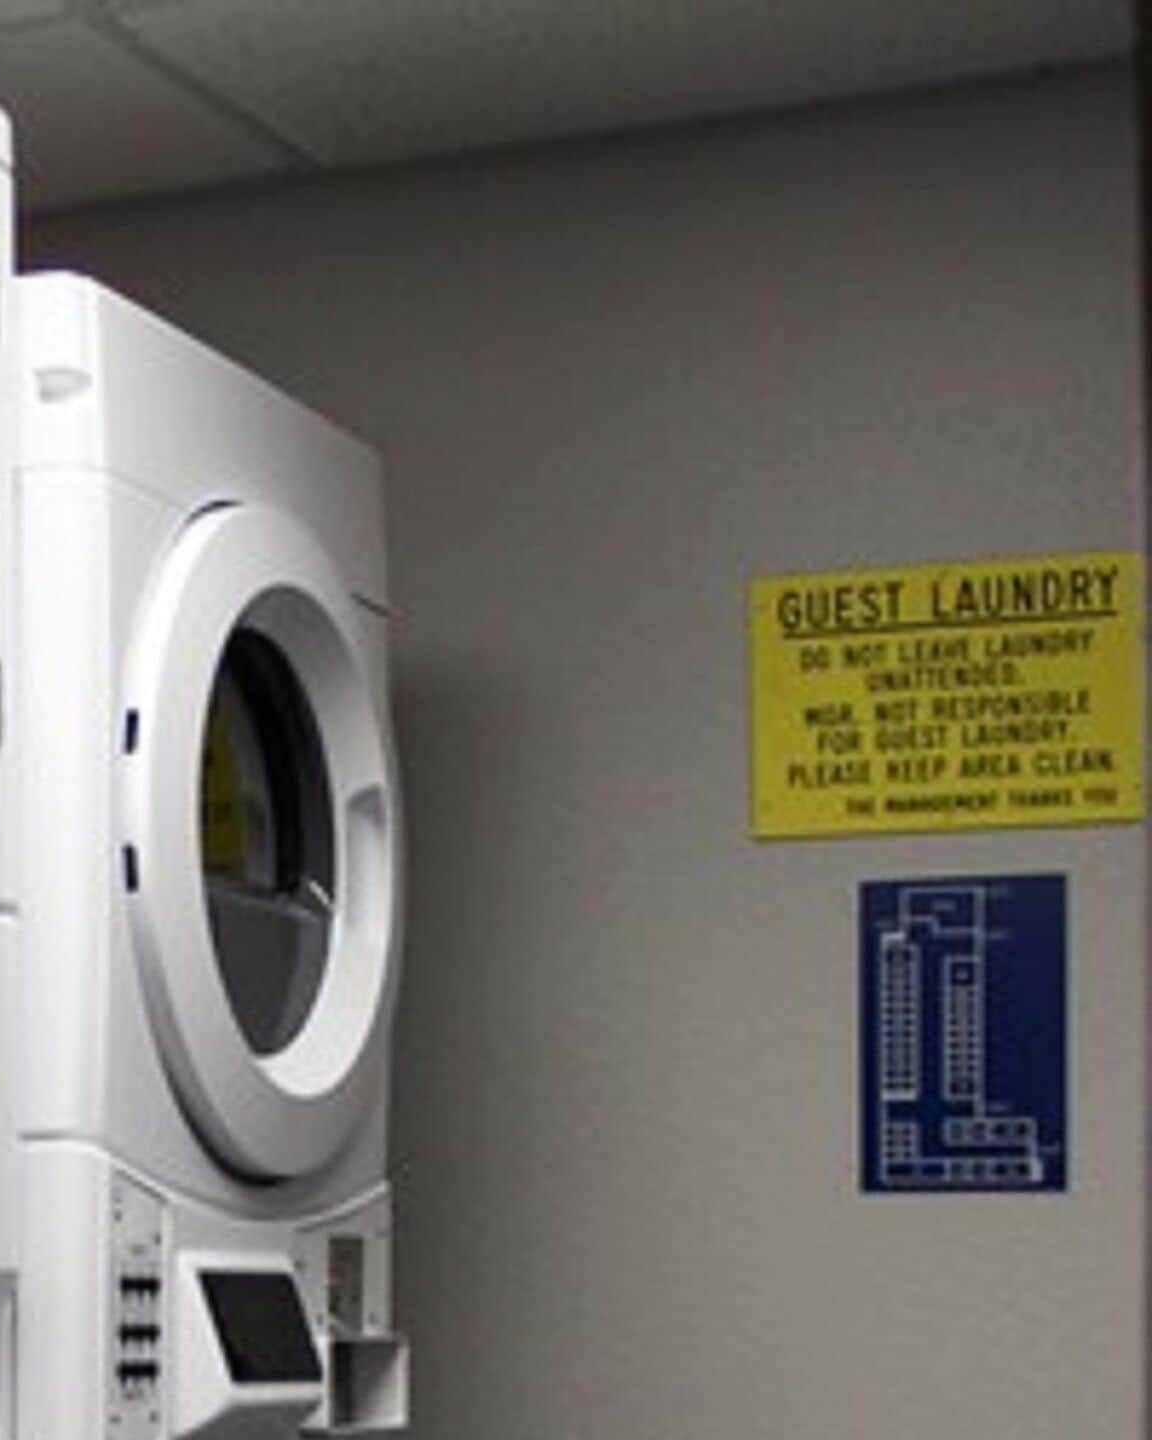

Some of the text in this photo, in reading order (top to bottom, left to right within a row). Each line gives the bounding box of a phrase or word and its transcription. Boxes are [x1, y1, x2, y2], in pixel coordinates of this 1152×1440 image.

[778, 565, 1118, 629] GUEST LAUNDRY
[800, 645, 831, 672] DO
[843, 642, 886, 668] NOT
[787, 761, 870, 789] PLEASE
